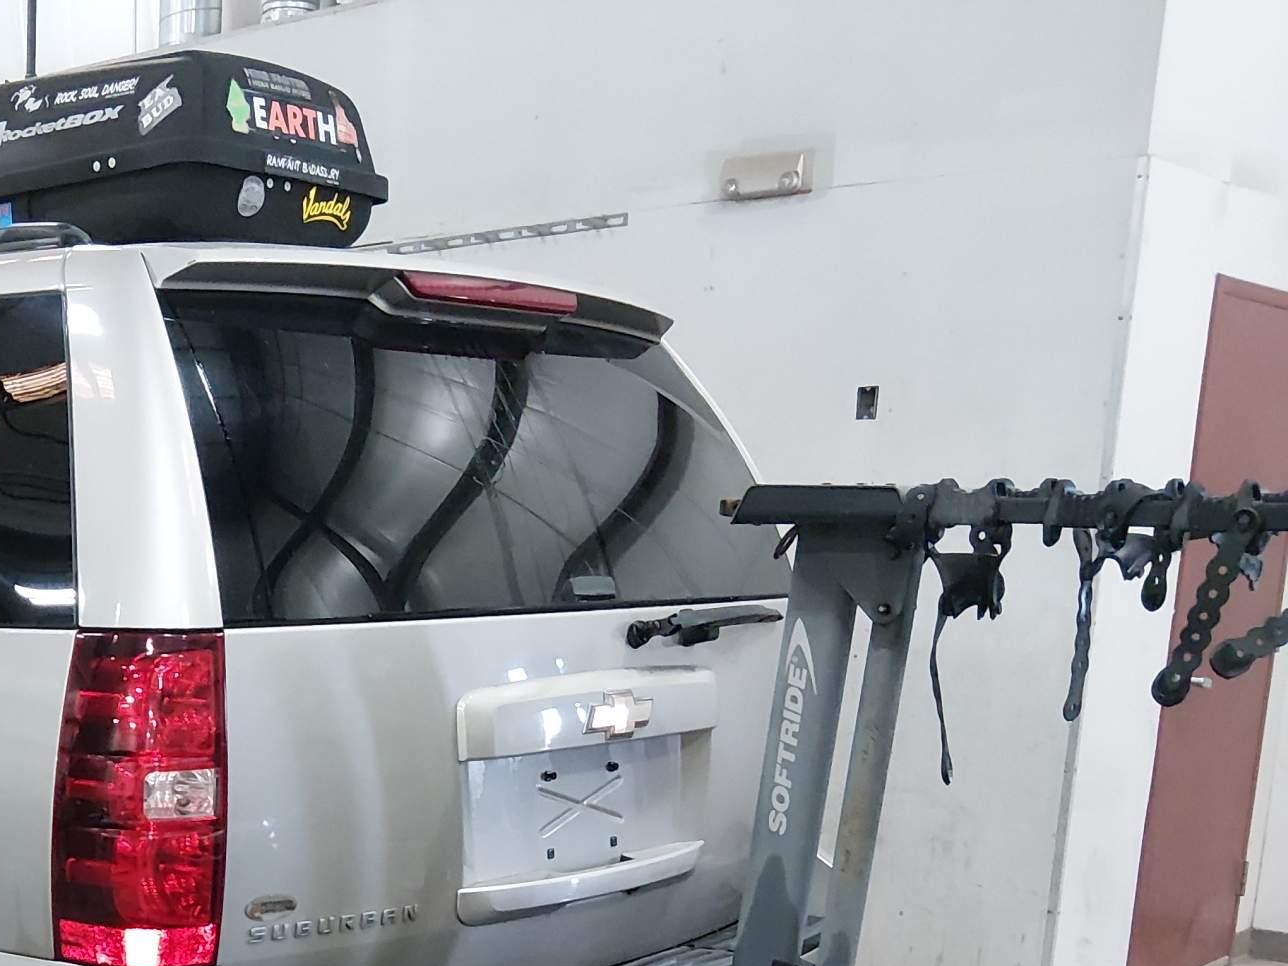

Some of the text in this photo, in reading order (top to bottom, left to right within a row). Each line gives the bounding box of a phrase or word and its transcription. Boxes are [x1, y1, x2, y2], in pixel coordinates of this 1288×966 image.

[253, 96, 337, 145] EARTH
[768, 663, 808, 836] SOFTRIDE
[248, 903, 419, 945] SUBURBAN
